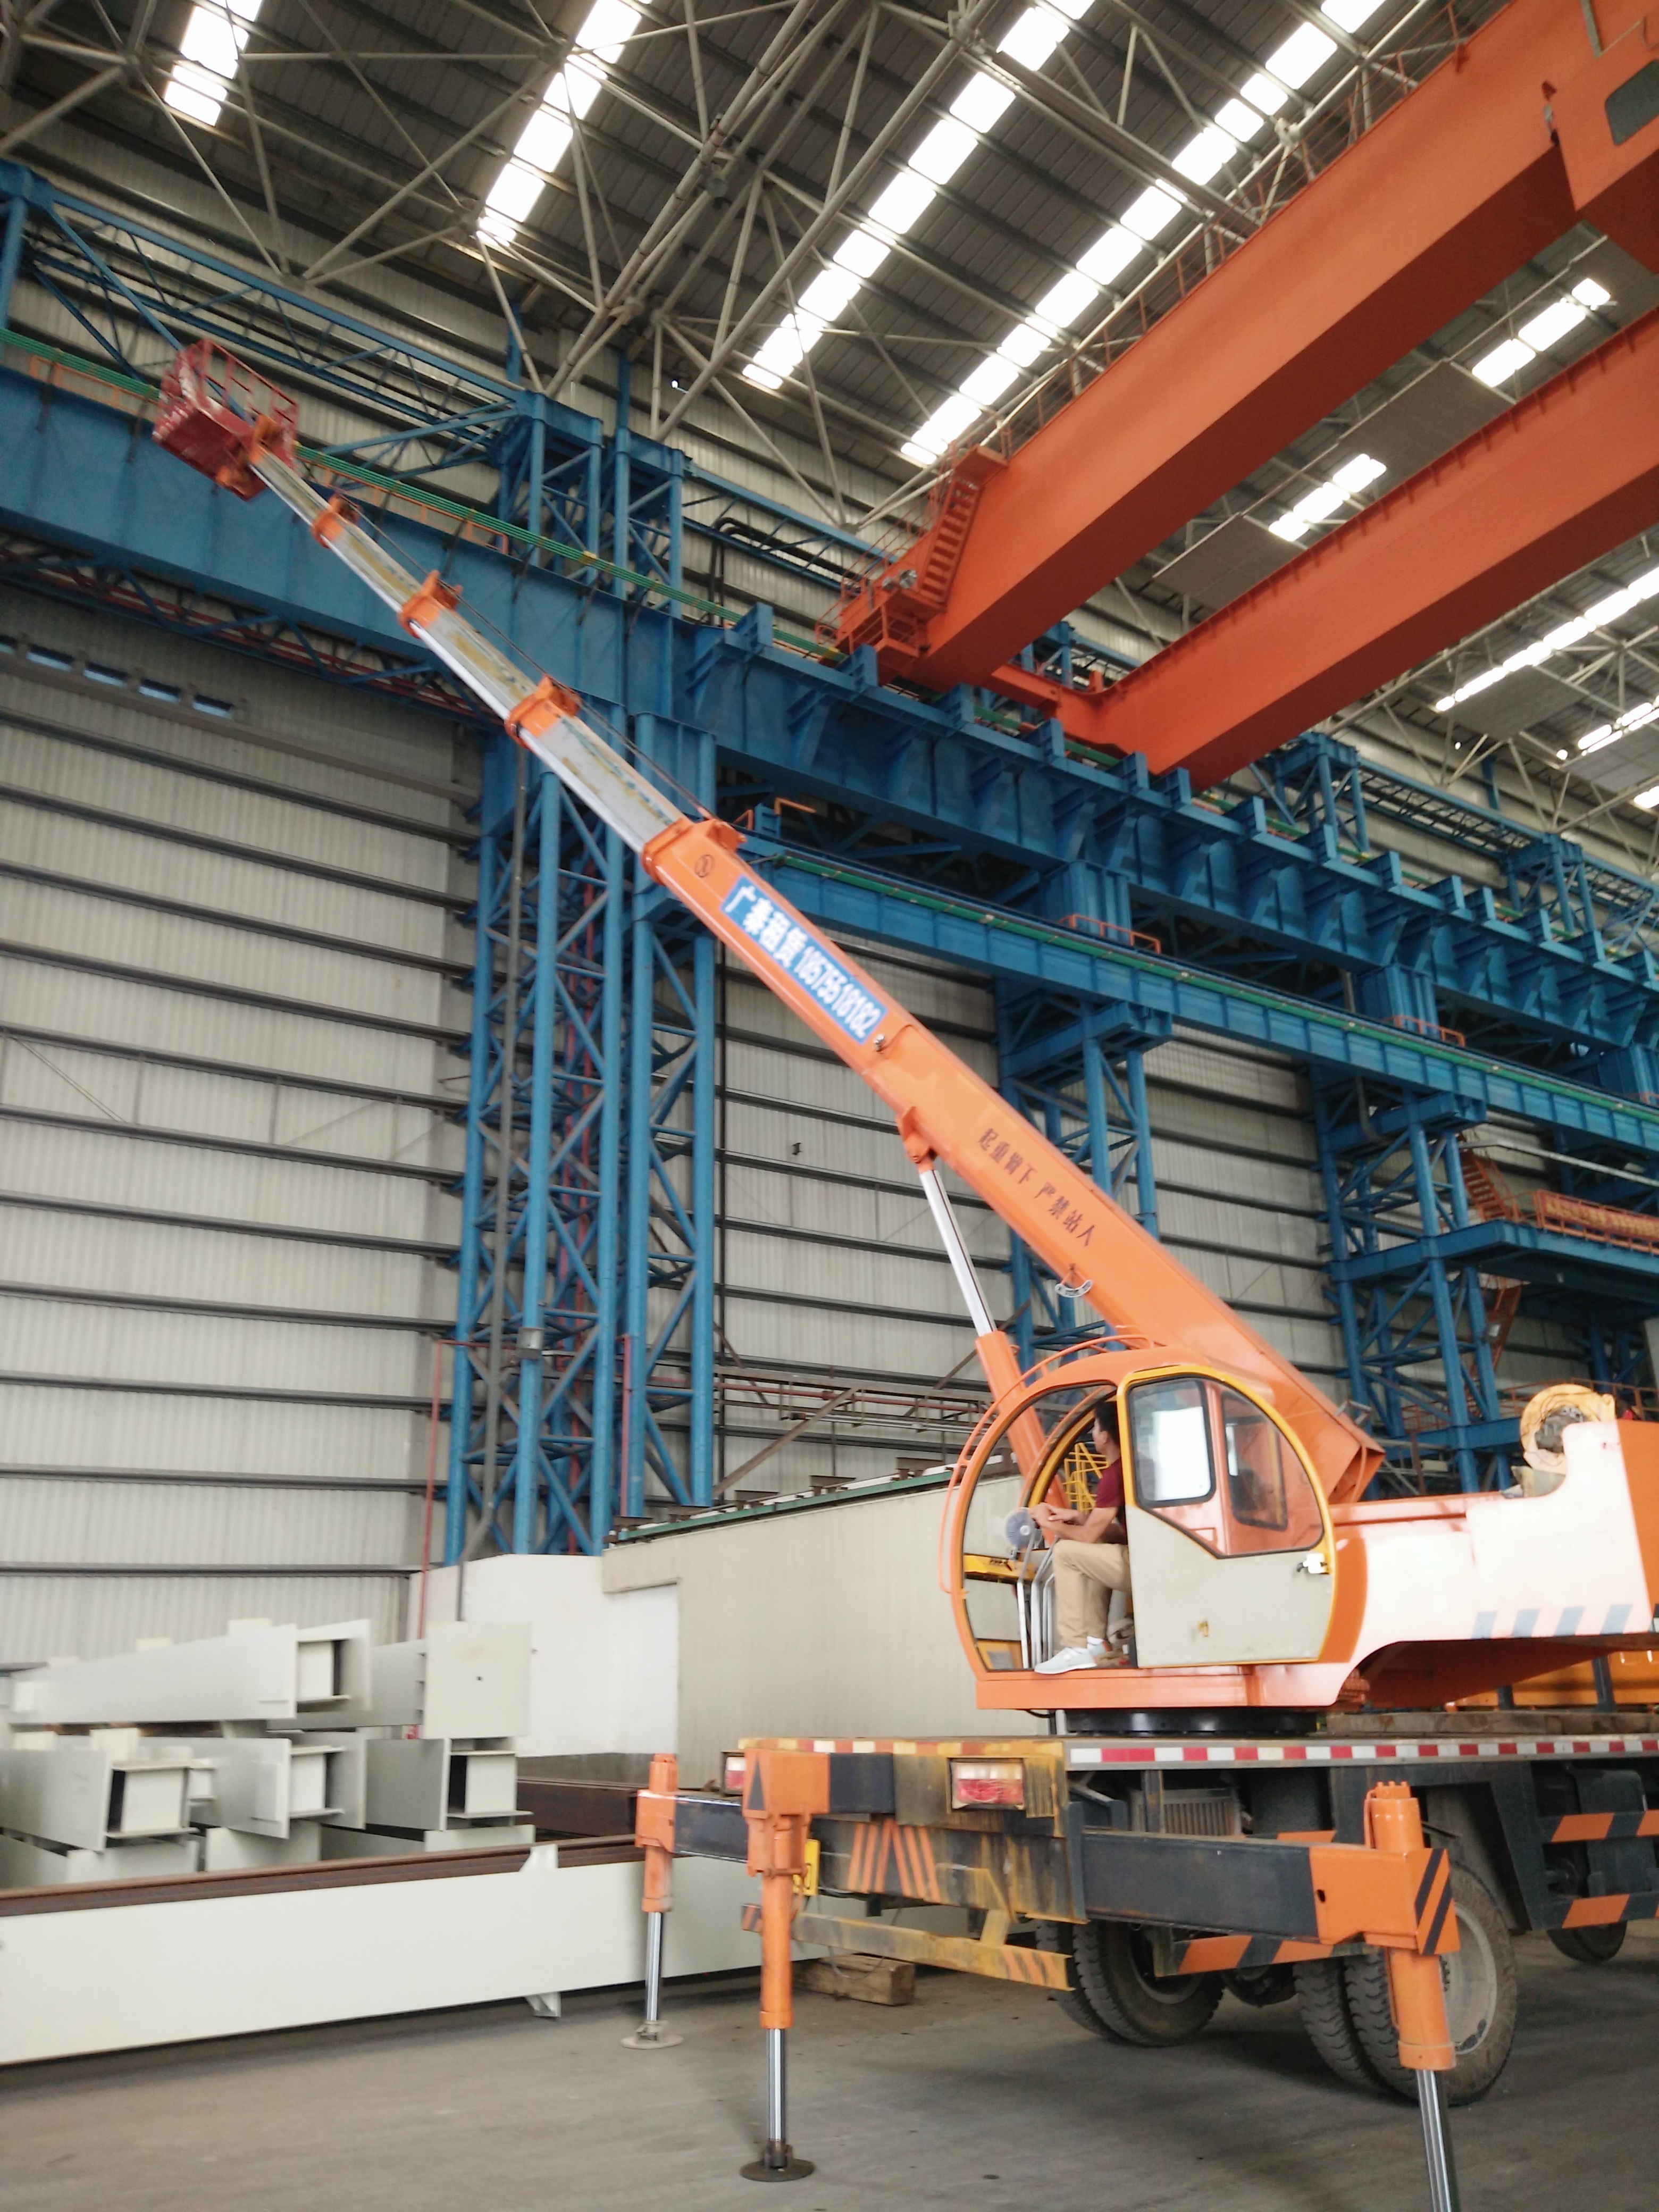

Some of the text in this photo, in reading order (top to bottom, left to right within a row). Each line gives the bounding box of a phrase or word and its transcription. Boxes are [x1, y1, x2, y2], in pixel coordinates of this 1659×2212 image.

[978, 1128, 1037, 1184] 起重臂下
[1034, 1182, 1095, 1246] 严禁站人
